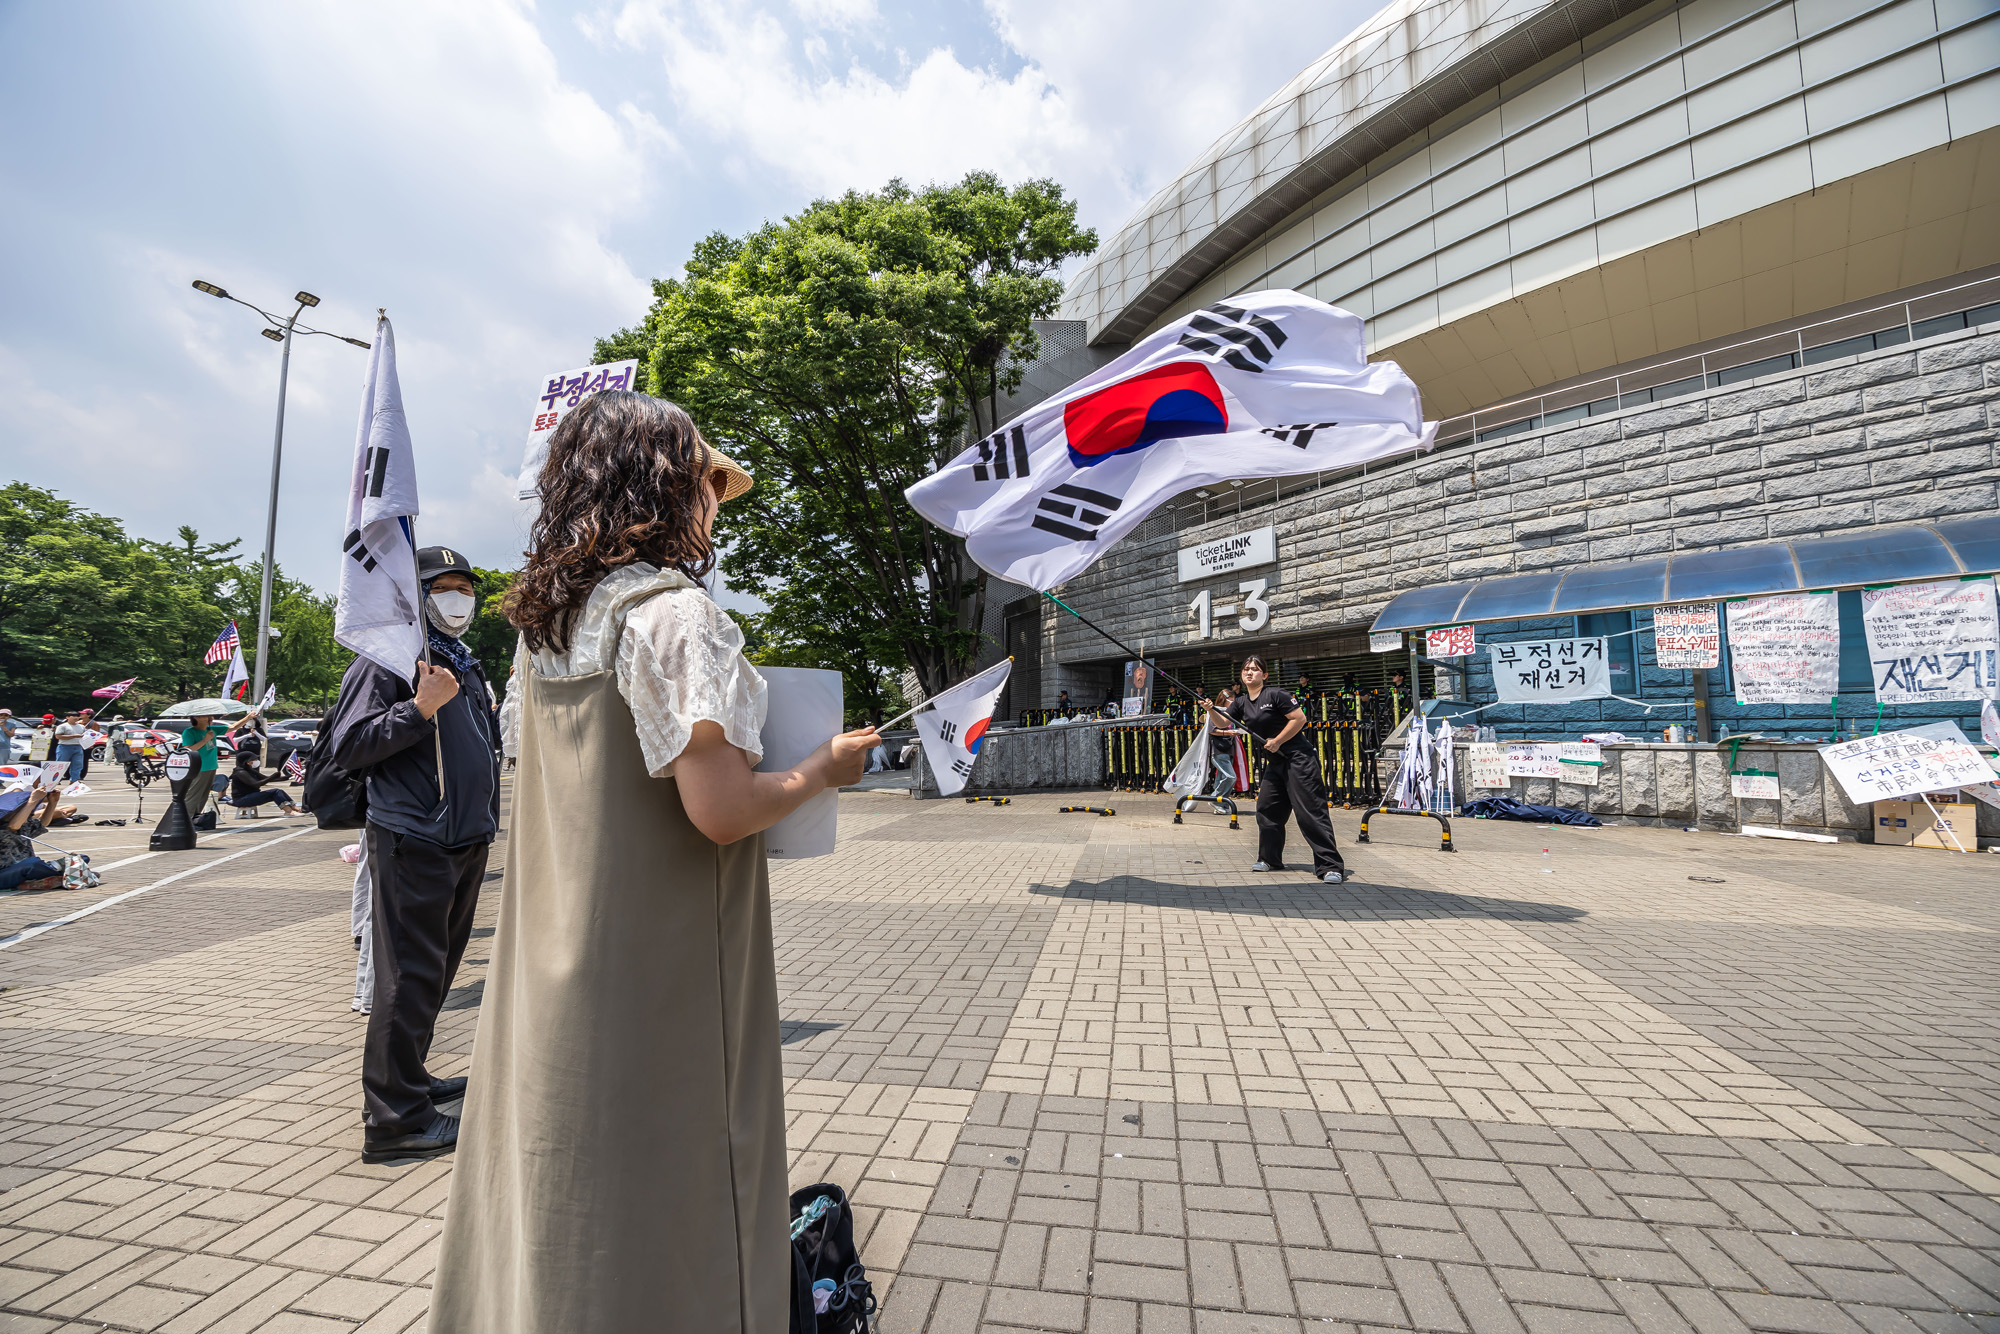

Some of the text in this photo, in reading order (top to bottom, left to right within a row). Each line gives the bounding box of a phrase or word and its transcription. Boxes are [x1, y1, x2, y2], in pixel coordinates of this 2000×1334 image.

[441, 549, 455, 566] B
[1195, 535, 1252, 560] ticketLINK
[1200, 549, 1246, 567] LIVE ARENA
[1189, 578, 1270, 638] 1-3
[1448, 640, 1475, 656] D-8
[1656, 635, 1719, 651] 투표소수개표
[1498, 639, 1602, 669] 부정선거
[1518, 666, 1586, 690] 재선거
[1873, 649, 1997, 693] 재선거!
[1879, 692, 1928, 703] FREEDOM
